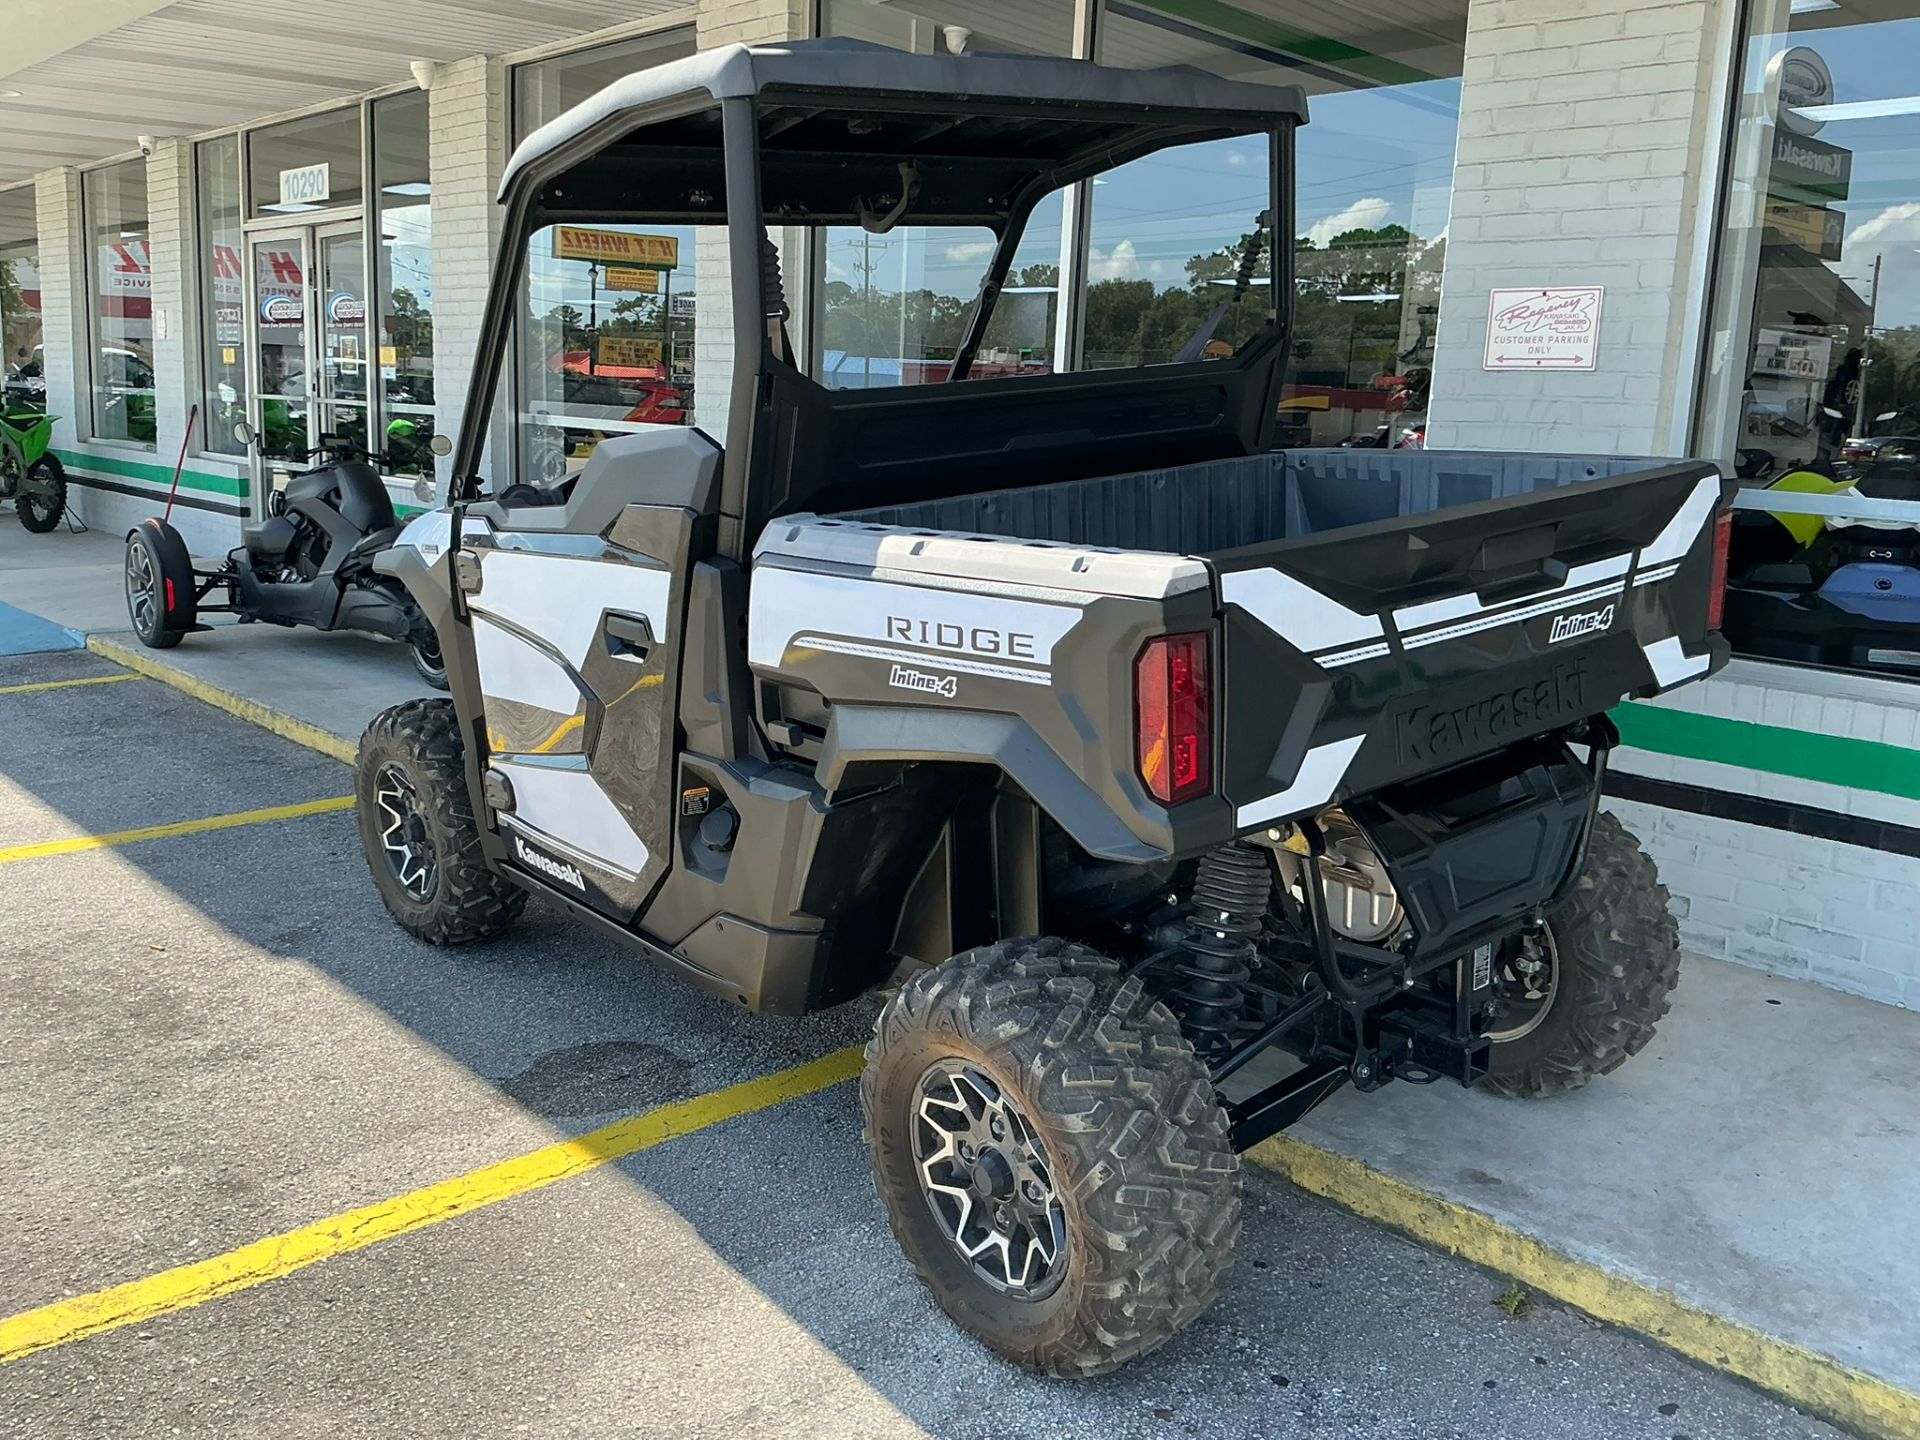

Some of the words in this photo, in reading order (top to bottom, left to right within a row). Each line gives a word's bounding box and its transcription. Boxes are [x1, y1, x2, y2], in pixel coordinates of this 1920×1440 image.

[285, 168, 324, 200] 10290
[1500, 298, 1582, 328] Regency
[1494, 335, 1544, 345] CUSTOMER
[1548, 335, 1589, 344] PARKING
[1527, 346, 1552, 355] ONLY
[887, 615, 1035, 658] RIDGE
[1550, 605, 1614, 642] Inline-4
[890, 666, 957, 698] Inline-4
[1395, 656, 1587, 767] Kawasaki
[515, 836, 586, 892] Kawasaki
